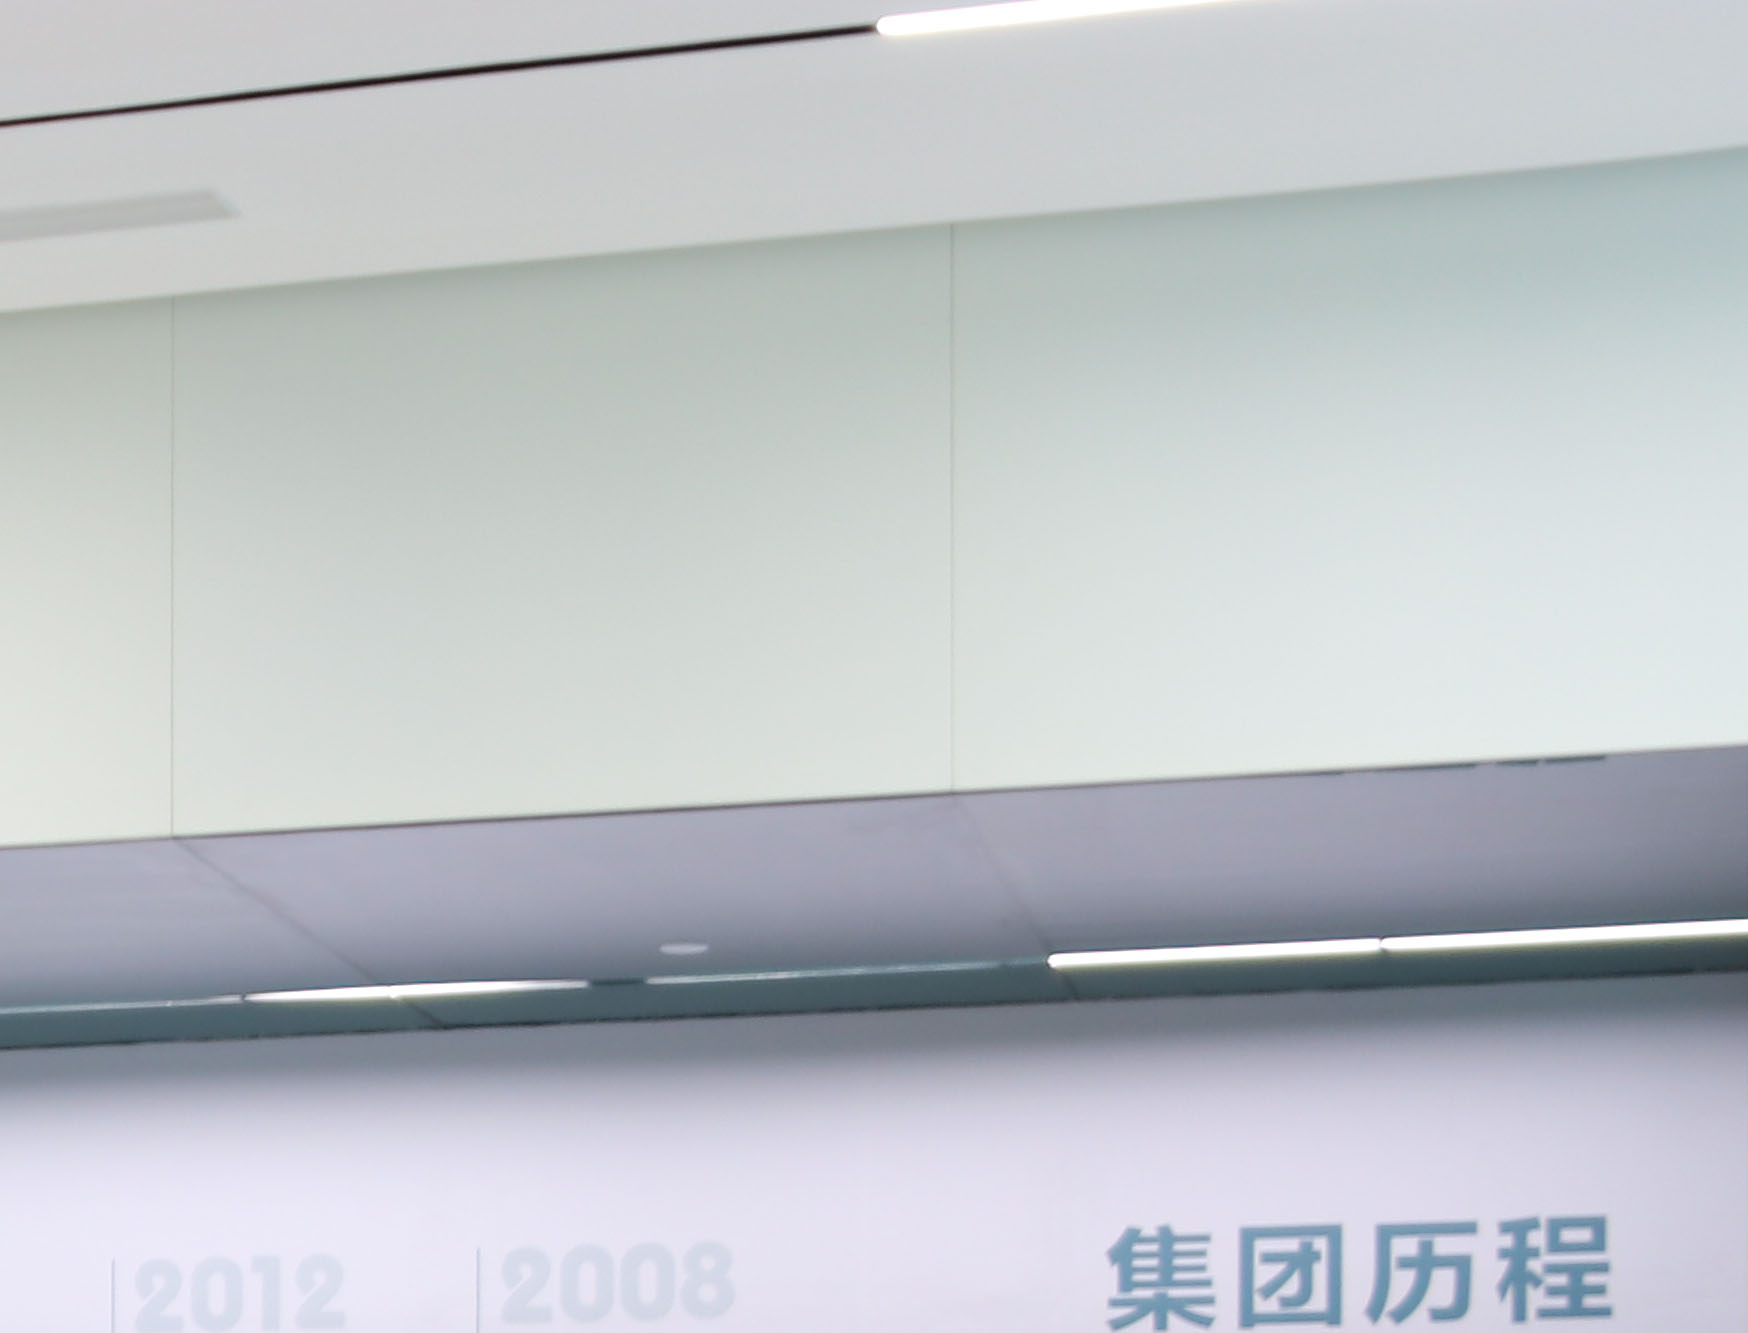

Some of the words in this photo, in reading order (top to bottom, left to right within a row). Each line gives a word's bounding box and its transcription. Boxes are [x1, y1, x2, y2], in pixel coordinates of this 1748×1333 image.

[501, 1240, 736, 1325] 2008
[1105, 1215, 1613, 1333] 集团历程
